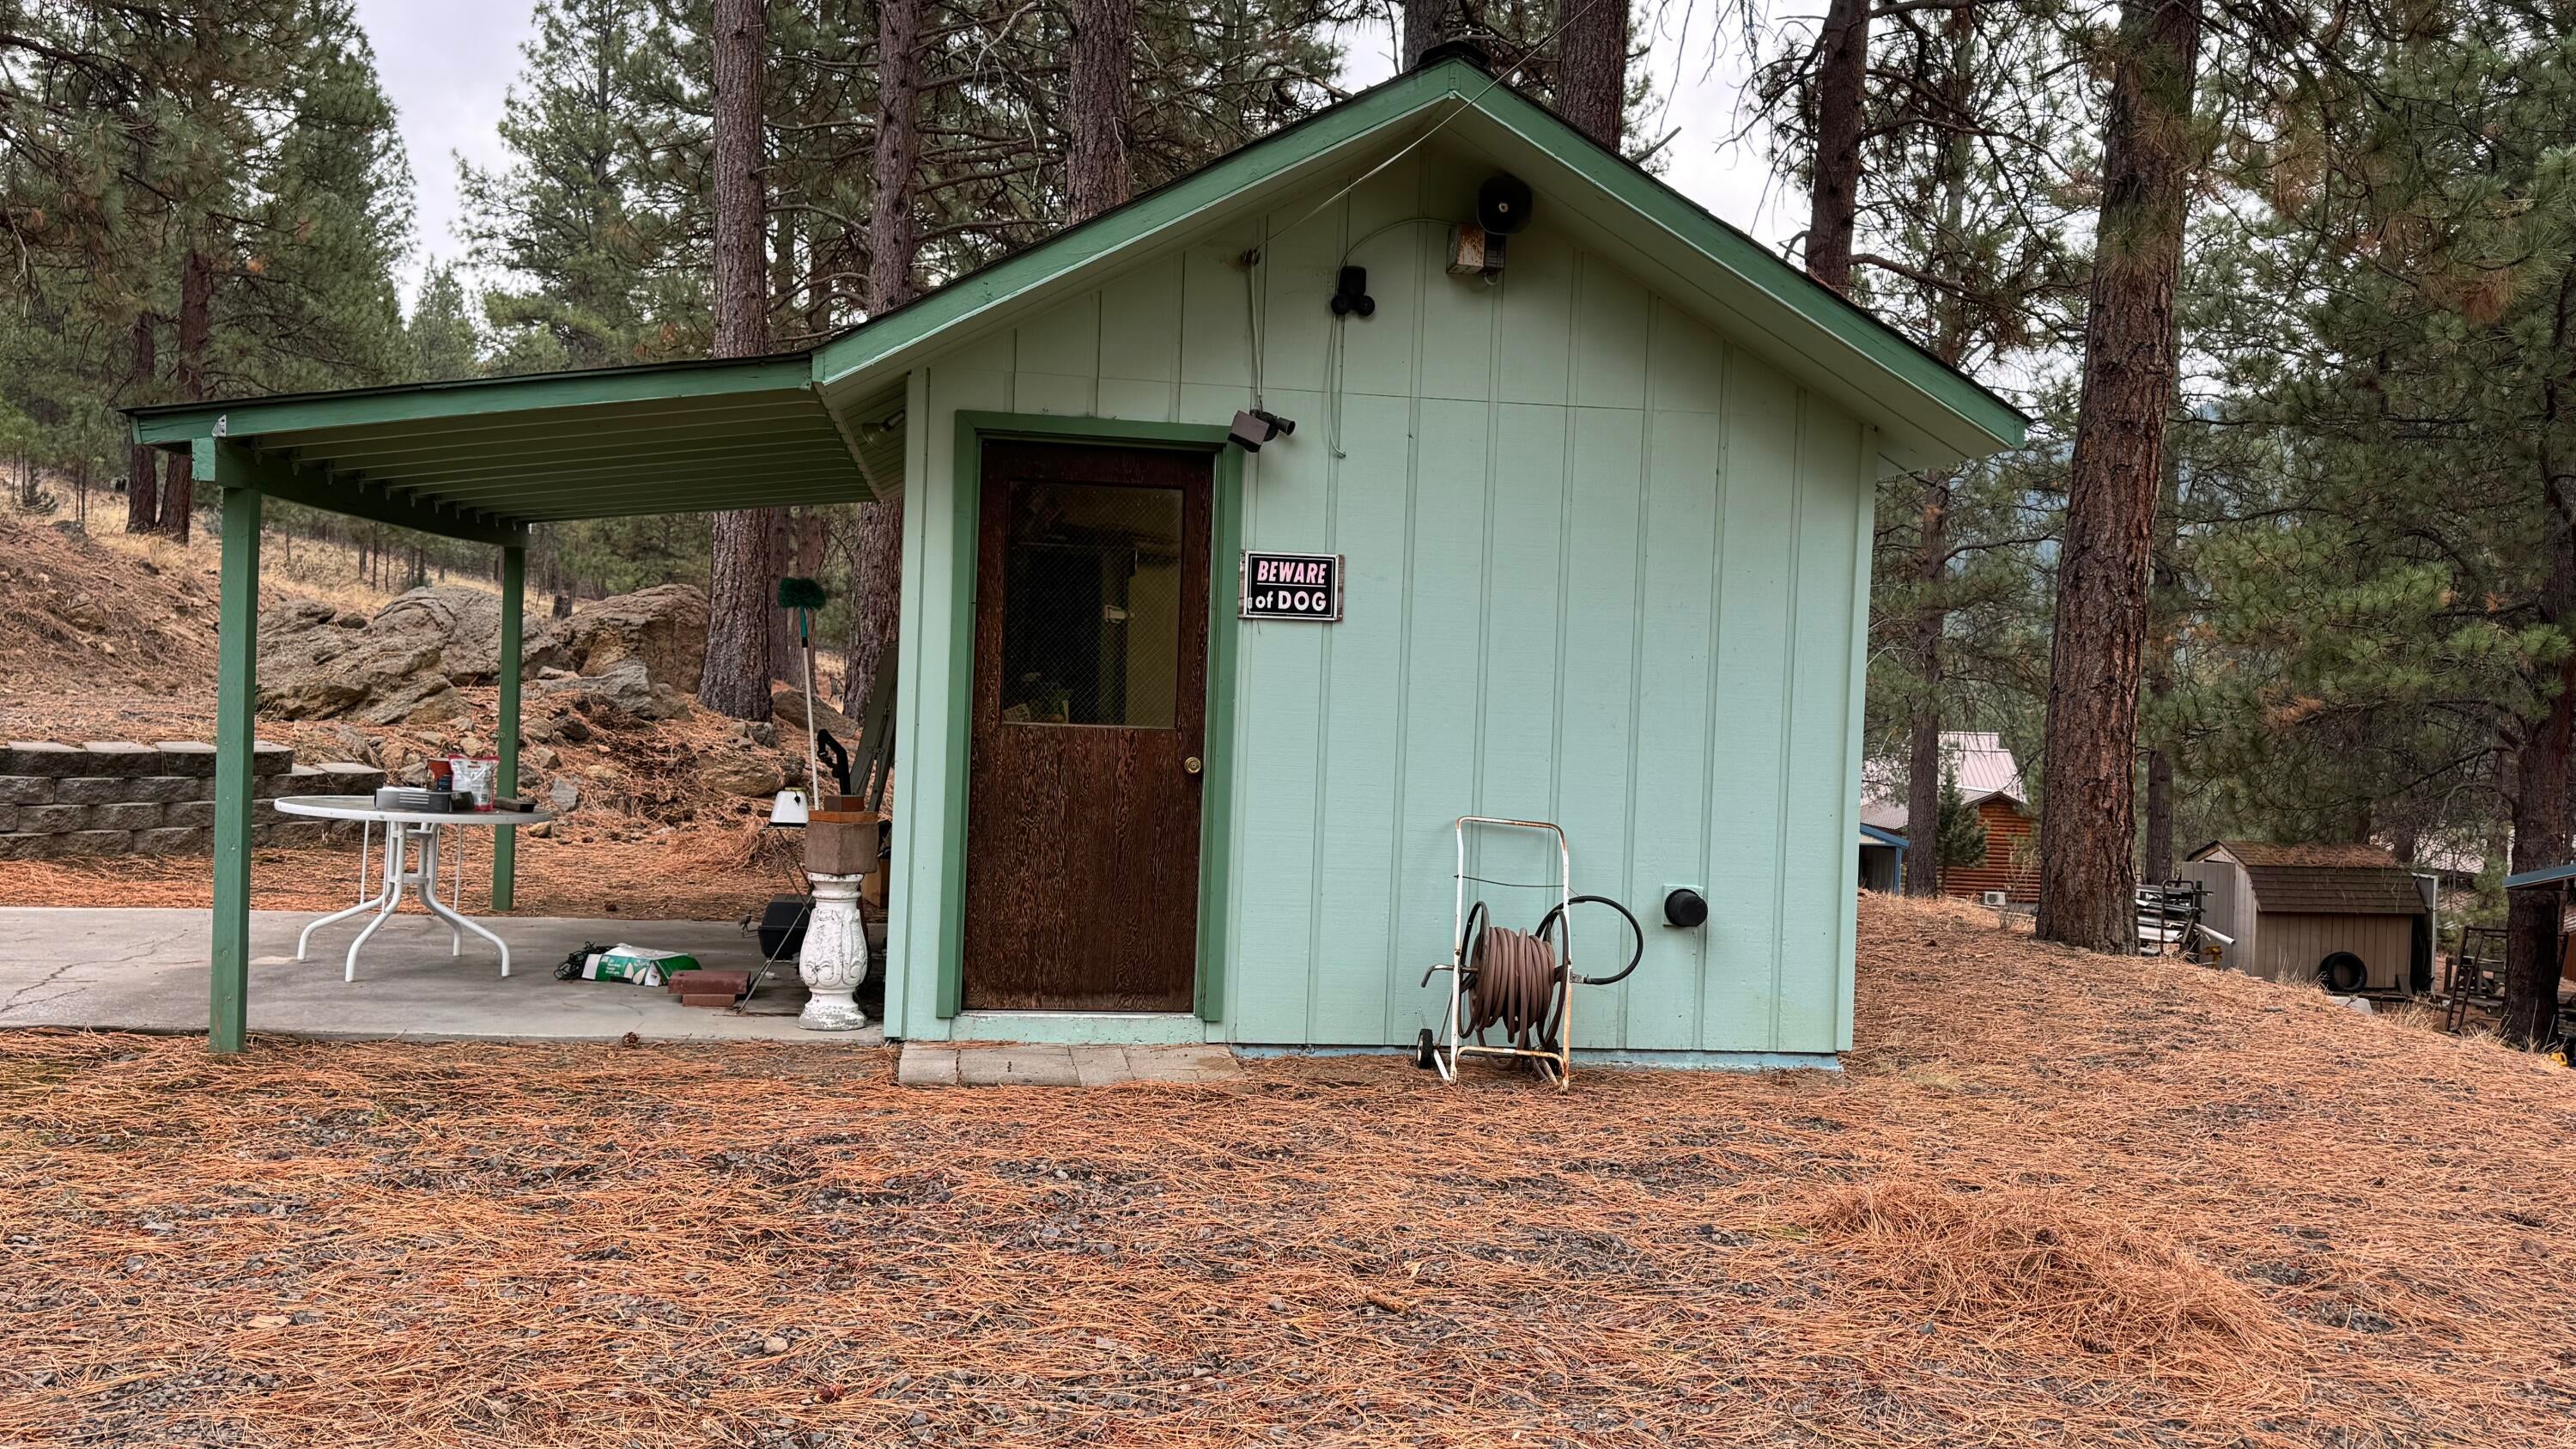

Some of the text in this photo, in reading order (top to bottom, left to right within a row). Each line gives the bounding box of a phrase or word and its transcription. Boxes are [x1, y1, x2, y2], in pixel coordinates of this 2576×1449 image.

[1257, 560, 1327, 584] BEWARE
[1255, 590, 1327, 612] of DOG
